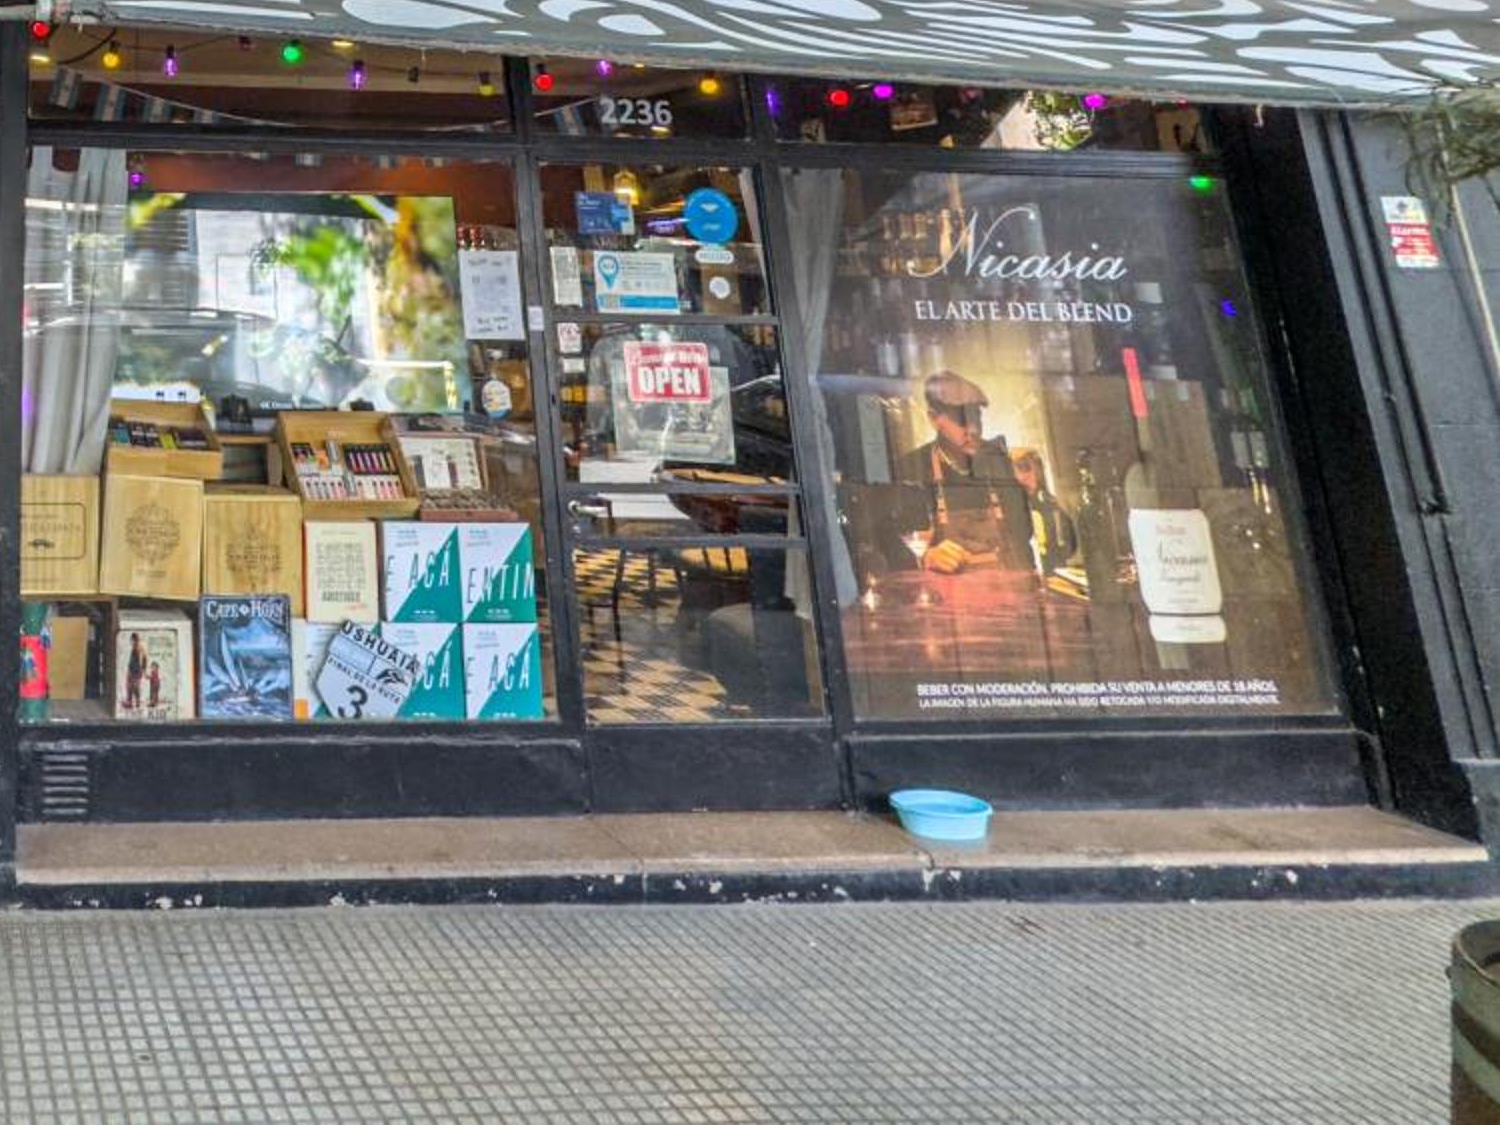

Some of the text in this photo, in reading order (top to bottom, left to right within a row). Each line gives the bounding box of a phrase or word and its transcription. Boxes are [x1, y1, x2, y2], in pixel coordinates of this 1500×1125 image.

[599, 97, 673, 126] 2236
[906, 206, 1128, 282] Nicasia
[915, 300, 1132, 323] EL ARTE DEL BLEND
[638, 366, 701, 395] OPEN
[206, 599, 238, 620] CAPE
[338, 685, 368, 720] 3
[917, 684, 949, 696] BEBER
[951, 683, 974, 695] CON
[1051, 682, 1106, 695] PROHIBIDA
[1107, 682, 1120, 693] SU
[1121, 682, 1155, 693] VENTA
[1165, 681, 1216, 693] MENORES
[1217, 680, 1231, 692] DE
